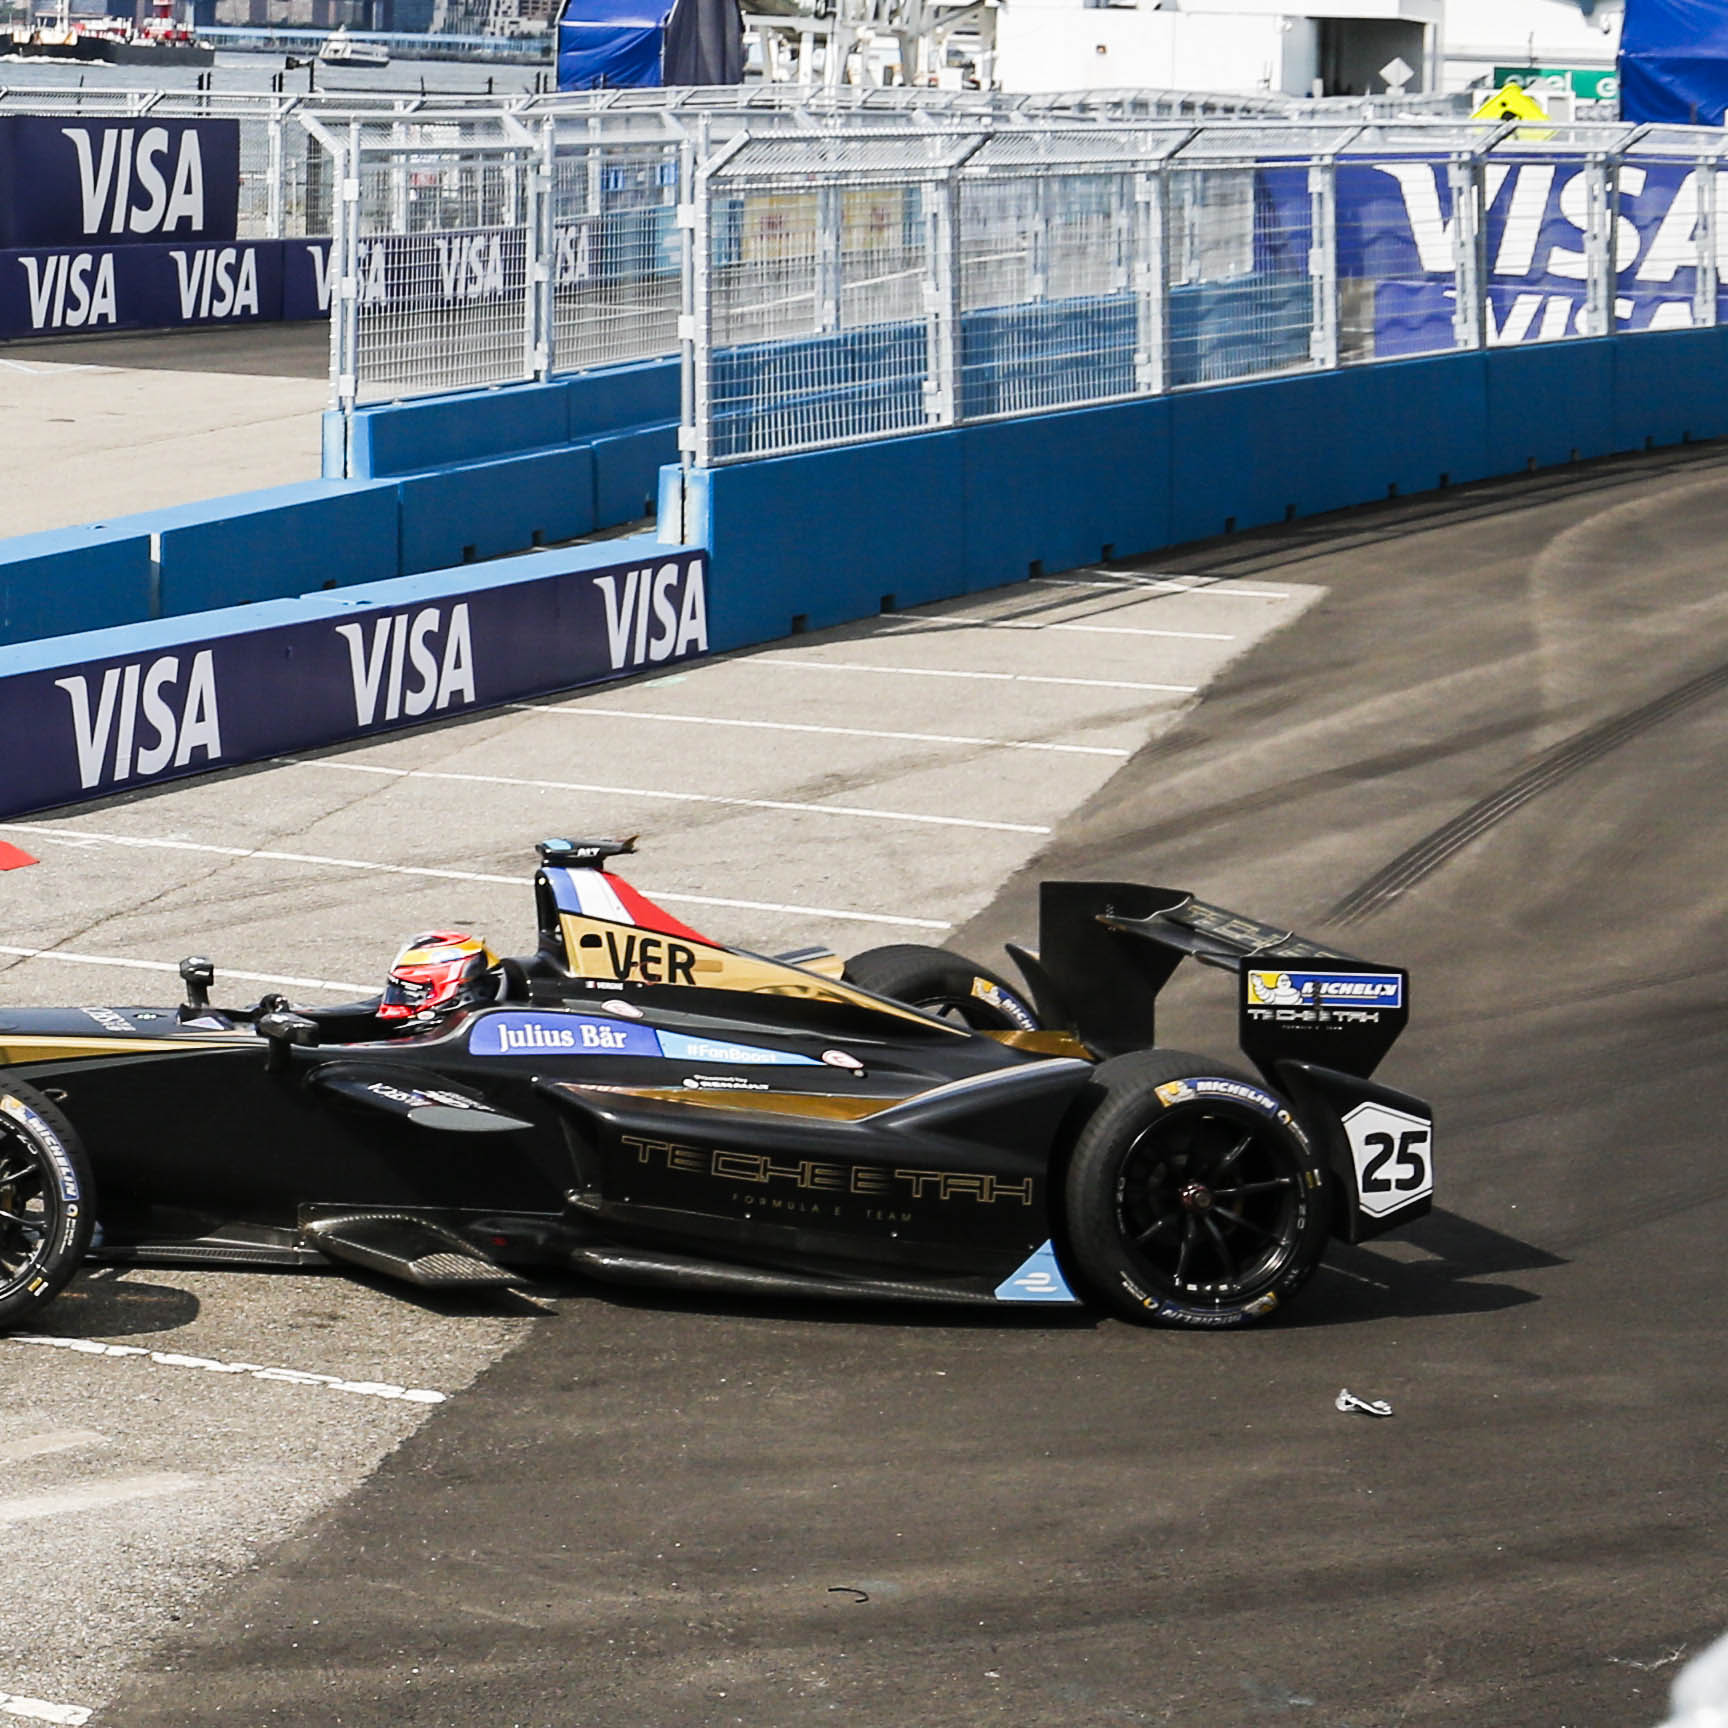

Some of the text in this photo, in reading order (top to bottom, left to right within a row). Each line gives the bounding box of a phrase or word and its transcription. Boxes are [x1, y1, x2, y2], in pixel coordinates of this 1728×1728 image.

[62, 127, 204, 234] VISA
[18, 252, 117, 329] VISA
[169, 247, 259, 319] VISA
[435, 233, 505, 302] VISA
[593, 558, 709, 670] VISA
[335, 602, 475, 727] VISA
[55, 649, 222, 789] VISA
[605, 930, 697, 986] VER
[1301, 981, 1398, 997] MICHELIN
[497, 1022, 628, 1053] Julius Bär
[1247, 1009, 1379, 1023] TECHEETAH
[687, 1043, 777, 1064] #FanBoost
[1196, 1081, 1276, 1109] MICHELIN
[29, 1117, 78, 1197] MICHELIN
[622, 1135, 1034, 1206] TECHEETAH
[1362, 1130, 1429, 1194] 25
[730, 1191, 822, 1214] FORMULA
[866, 1208, 913, 1222] TEAM
